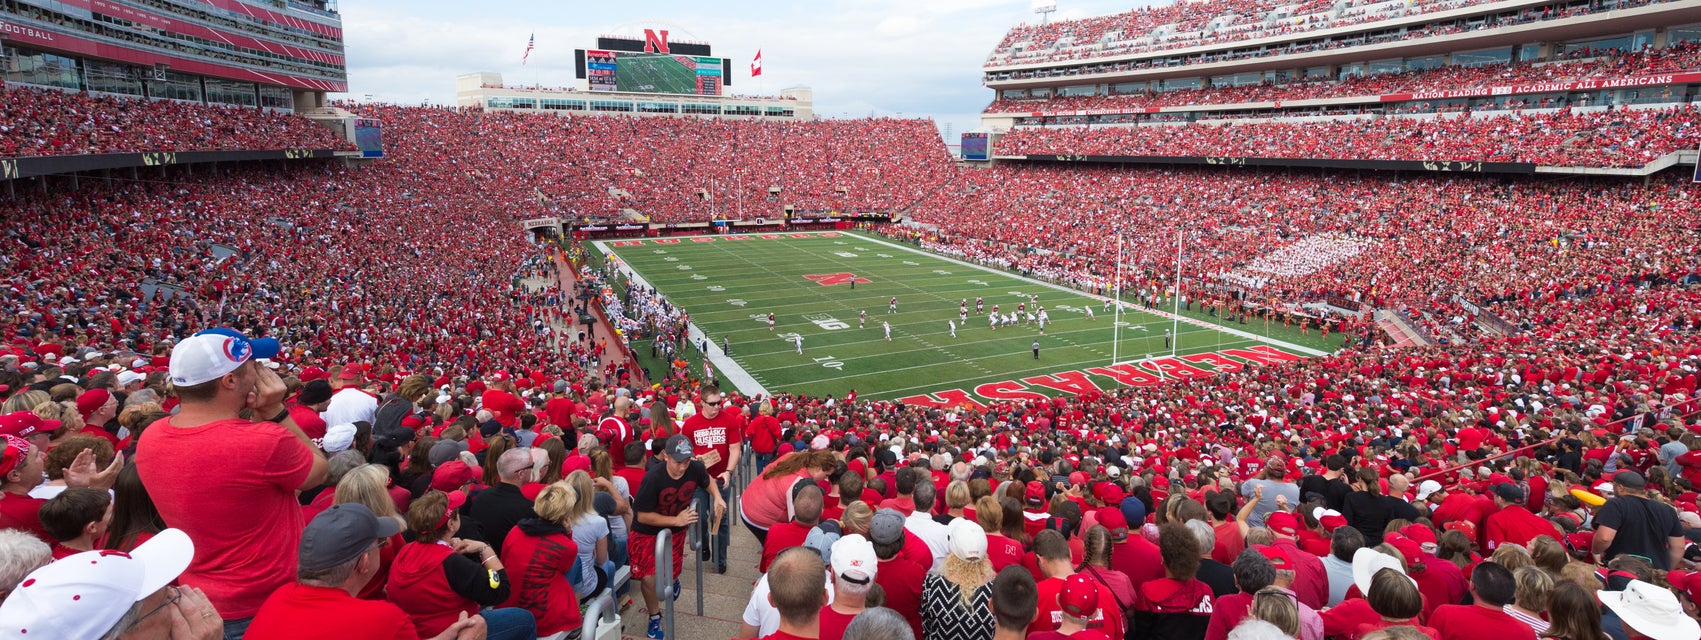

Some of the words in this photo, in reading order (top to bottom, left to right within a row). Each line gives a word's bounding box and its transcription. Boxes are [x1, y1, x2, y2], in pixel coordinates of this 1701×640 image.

[0, 22, 53, 41] FOOTBALL
[644, 29, 670, 54] N
[1412, 92, 1445, 100] NATION
[1448, 88, 1488, 98] LEADING
[1516, 83, 1572, 93] ACADEMIC
[1577, 80, 1597, 90] ALL
[1602, 75, 1673, 88] AMERICANS
[812, 355, 845, 369] 10
[693, 428, 726, 438] NEBRASKA
[695, 436, 726, 446] HUSKERS
[659, 481, 696, 505] GO
[1005, 544, 1016, 555] N
